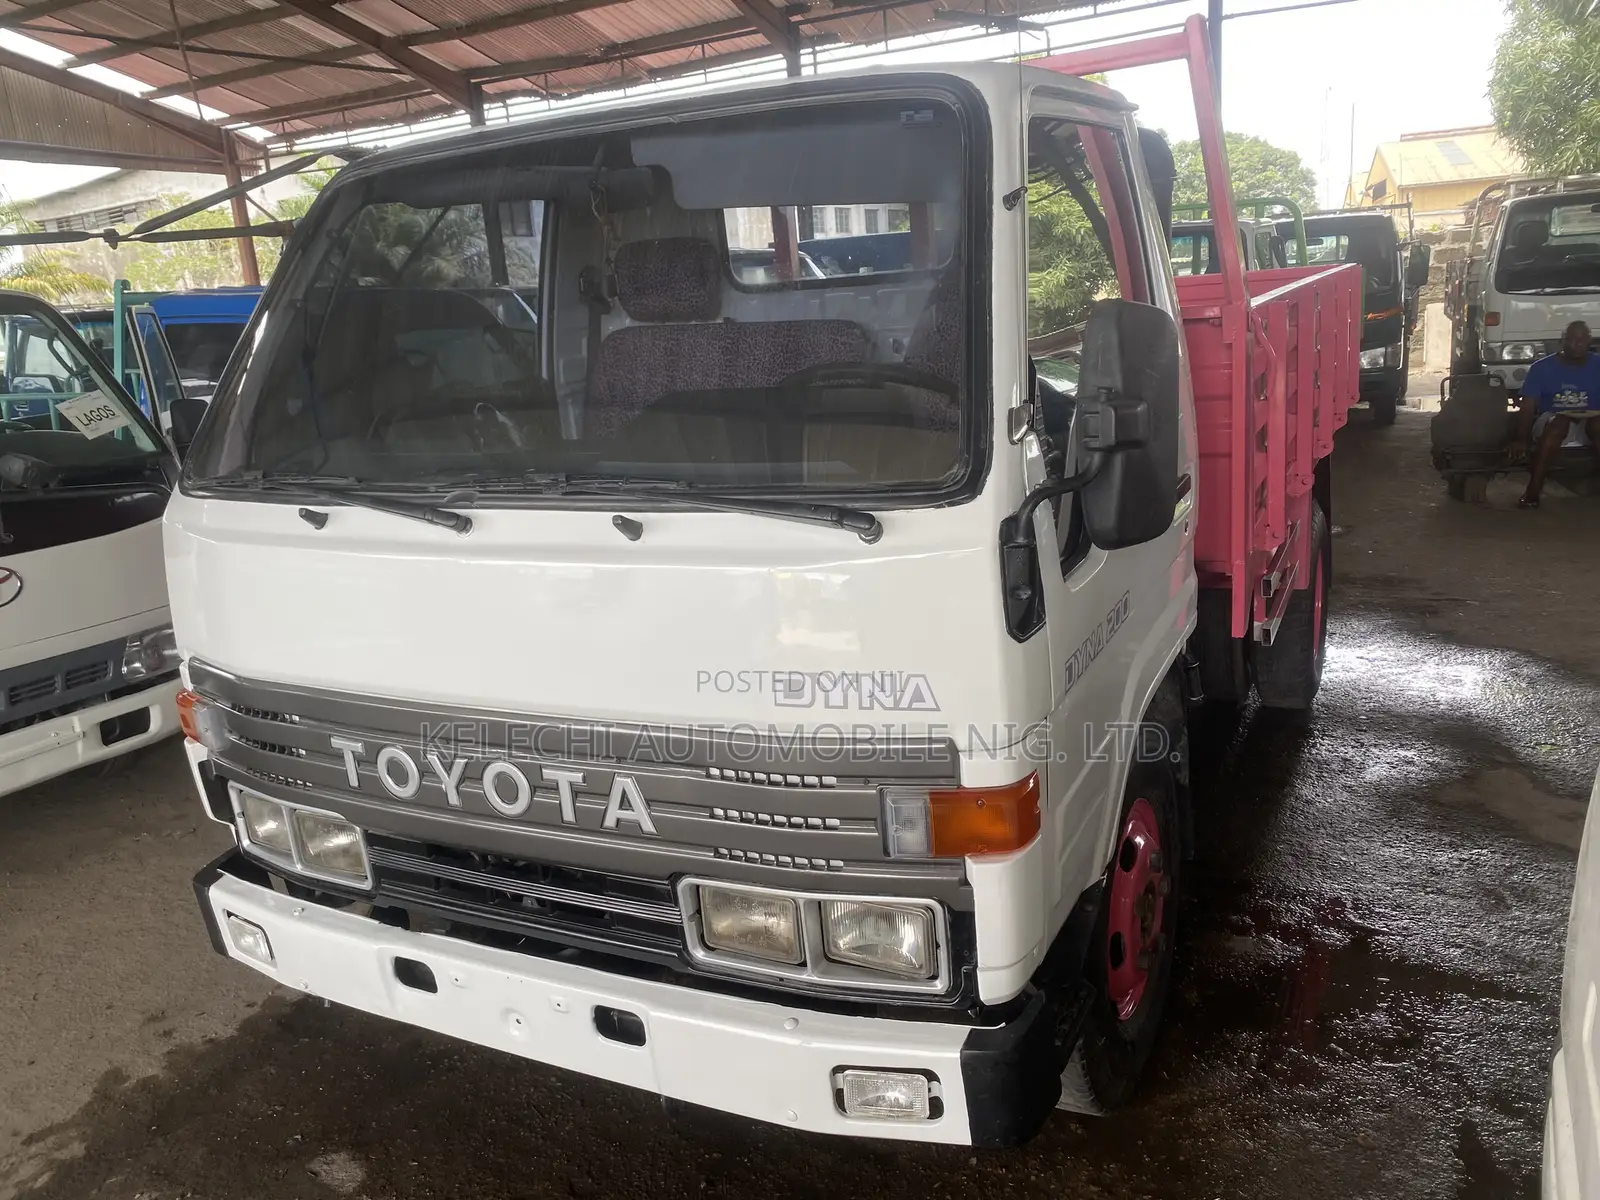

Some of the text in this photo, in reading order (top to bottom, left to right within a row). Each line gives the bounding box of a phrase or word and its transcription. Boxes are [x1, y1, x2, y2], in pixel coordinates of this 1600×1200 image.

[76, 405, 116, 427] LAGOS
[1065, 590, 1130, 695] DYNA 200
[774, 672, 941, 711] DYNA
[330, 735, 657, 836] TOYOTA
